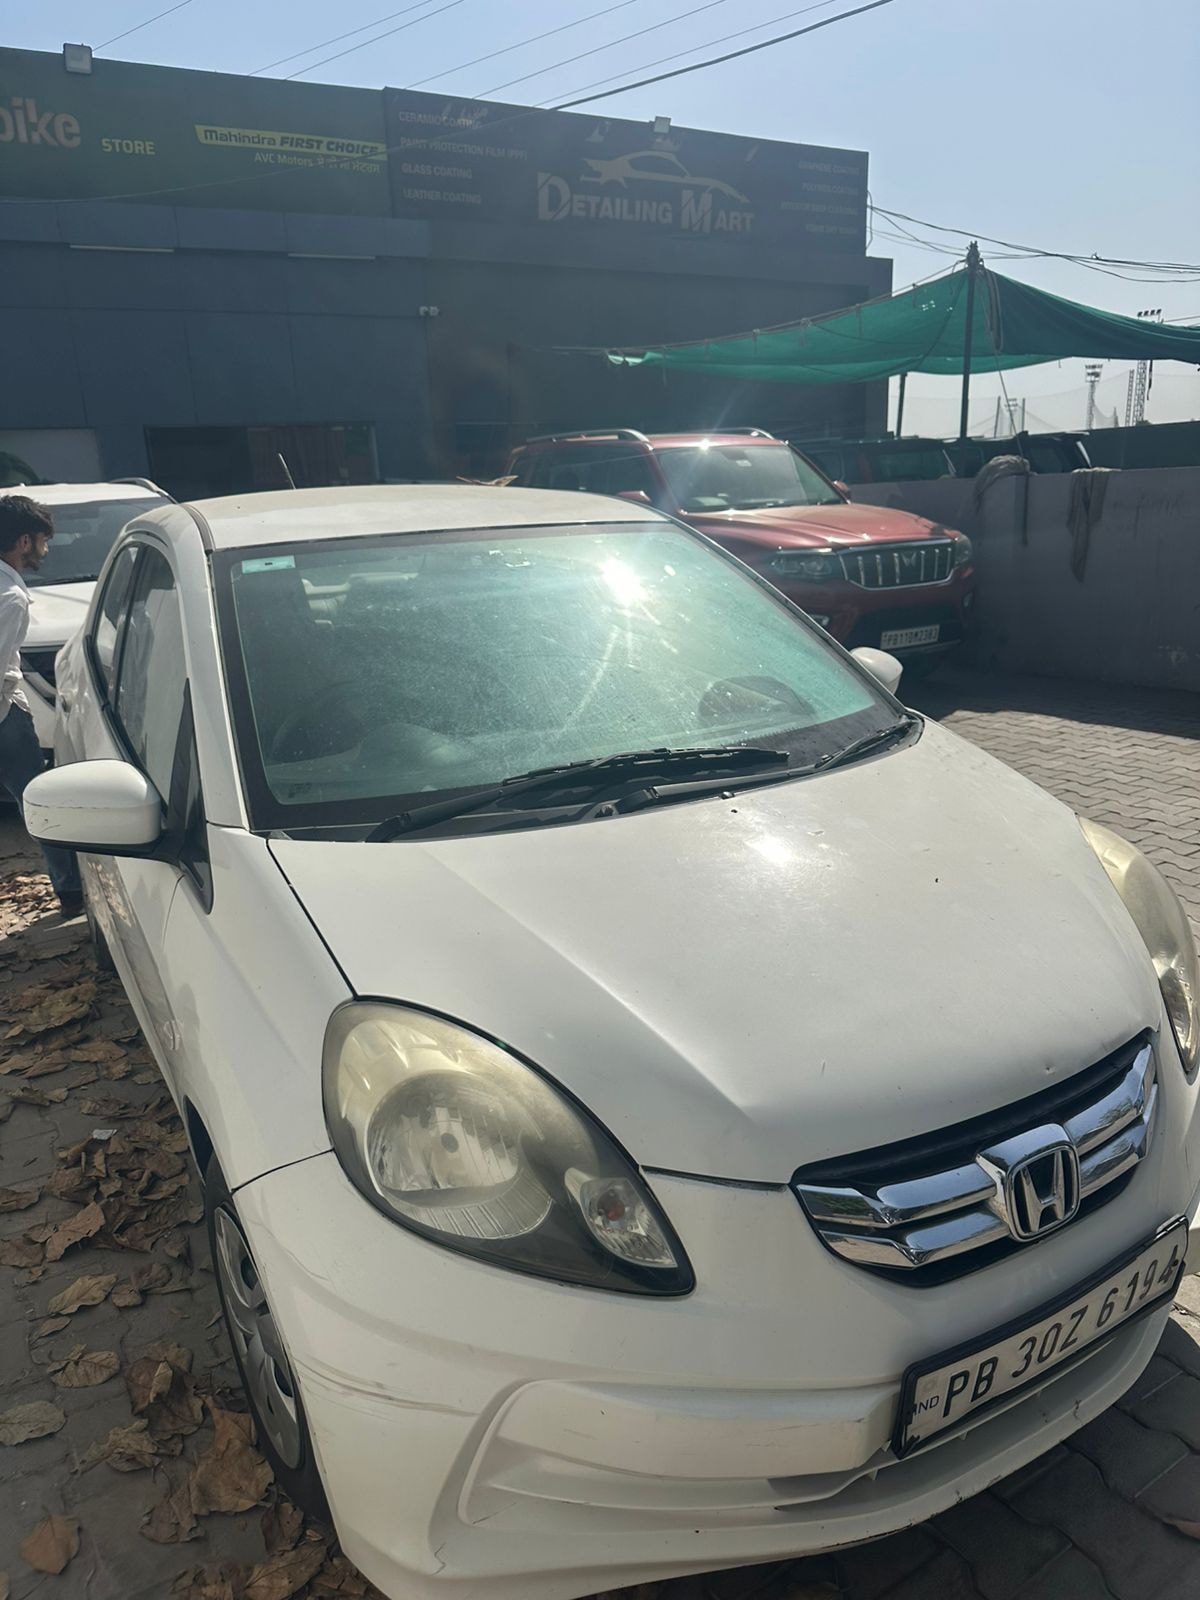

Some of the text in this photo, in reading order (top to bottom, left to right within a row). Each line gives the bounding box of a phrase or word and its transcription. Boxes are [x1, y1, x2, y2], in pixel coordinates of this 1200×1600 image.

[101, 137, 156, 155] STORE
[203, 129, 379, 155] Mahindra FIRST CHOICE
[430, 141, 484, 156] PROTECTION
[486, 145, 505, 158] FILM
[254, 152, 275, 164] AVC
[278, 155, 313, 168] Motors
[401, 162, 473, 179] GLASS COATING
[402, 186, 481, 204] LEATHER COATING
[537, 172, 755, 233] DETAILING MART
[942, 1244, 1178, 1418] PB 30Z 6194
